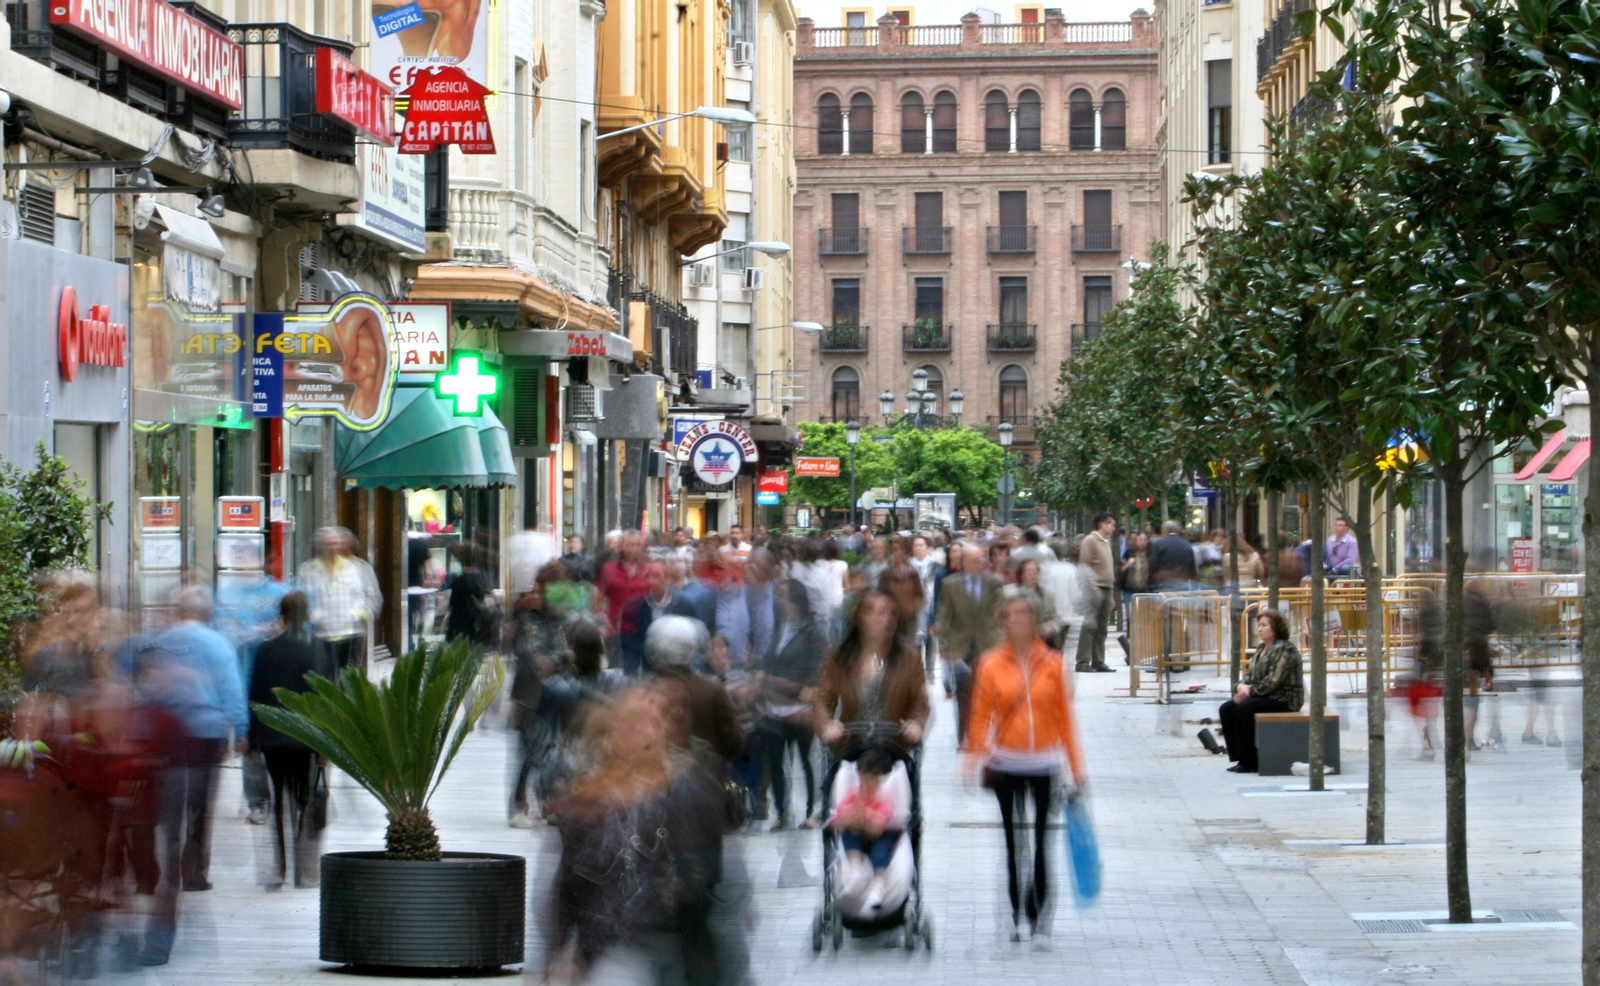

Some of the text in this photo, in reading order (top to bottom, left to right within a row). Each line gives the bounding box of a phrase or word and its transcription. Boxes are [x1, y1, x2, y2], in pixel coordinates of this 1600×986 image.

[378, 13, 422, 35] DIGITAL
[153, 3, 241, 105] INMOBILIARIA
[425, 82, 469, 93] AGENCIA
[413, 100, 481, 111] INMOBILIARIA
[252, 332, 332, 354] FETA
[298, 384, 332, 392] APARATOS
[679, 424, 709, 455] JEANS
[718, 422, 755, 456] CENTER
